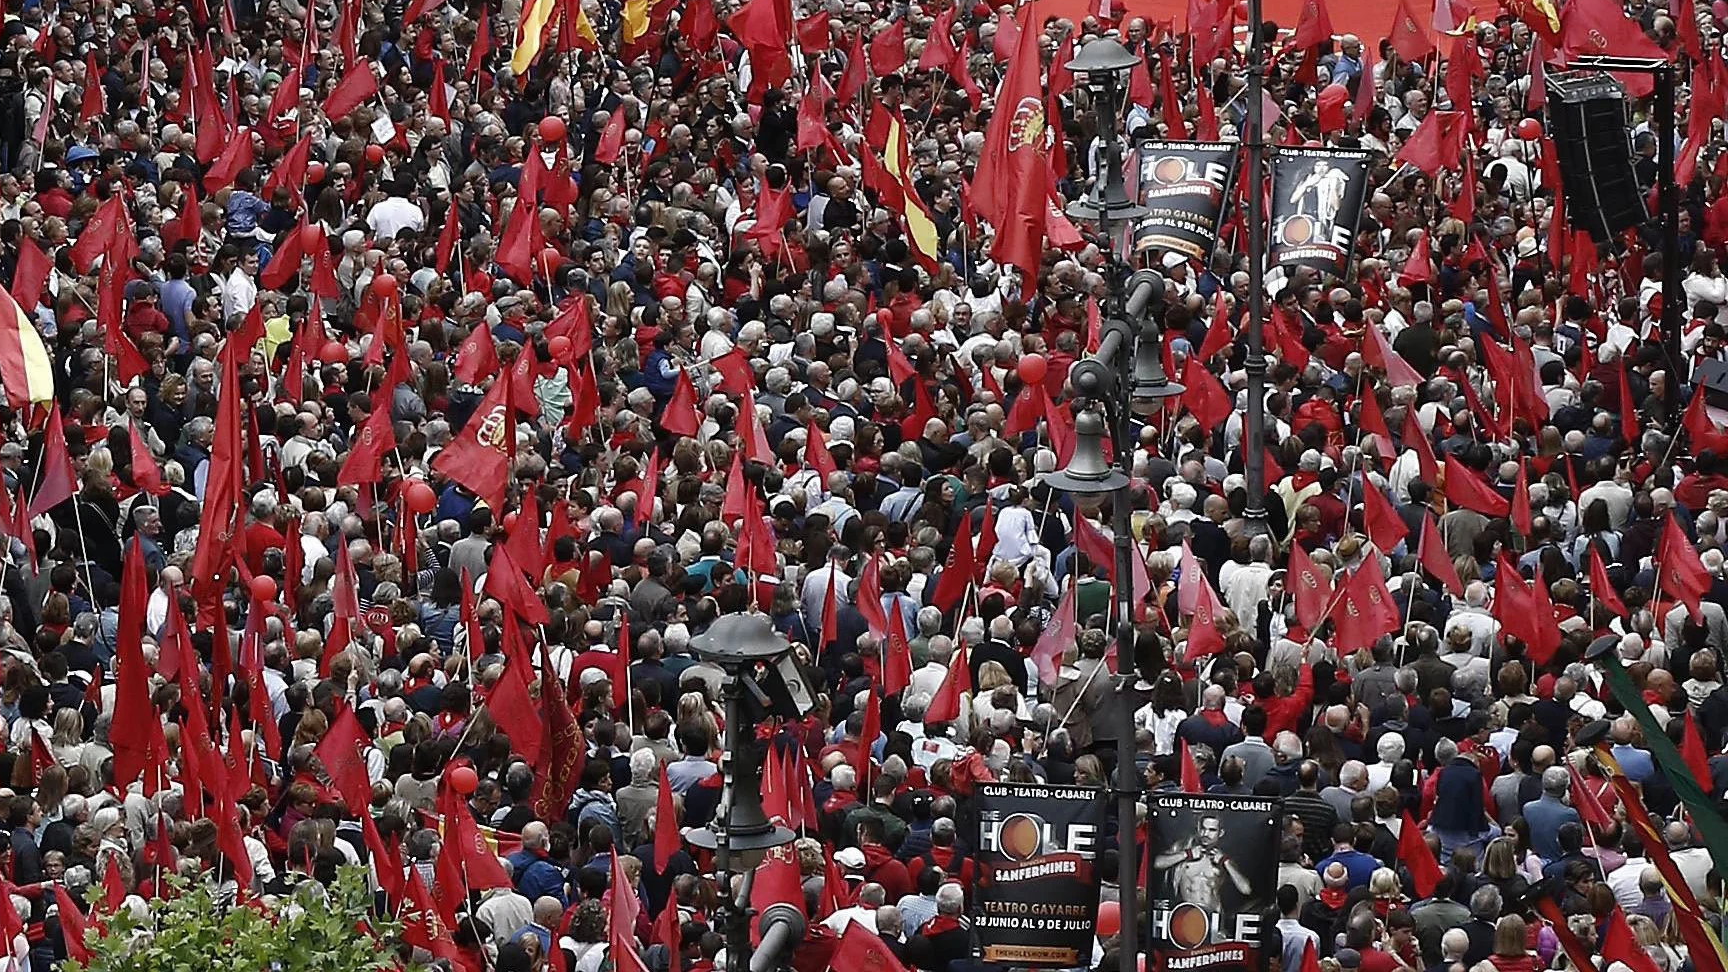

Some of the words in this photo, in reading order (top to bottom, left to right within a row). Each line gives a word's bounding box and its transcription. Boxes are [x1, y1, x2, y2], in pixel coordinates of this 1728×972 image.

[1141, 155, 1229, 191] HOLE
[1272, 214, 1352, 255] HOLE
[983, 785, 1008, 796] CLUB
[1013, 787, 1049, 798] TEATRO
[1054, 789, 1096, 800] CABARET
[1158, 797, 1183, 807] CLUB
[1189, 799, 1225, 809] TEATRO
[1230, 800, 1272, 811] CABARET
[980, 810, 1000, 821] THE
[980, 813, 1097, 861] HOLE
[995, 861, 1076, 881] SANFERMINES
[984, 901, 1028, 914] TEATRO
[1031, 903, 1087, 916] GAYARRE
[975, 916, 986, 926] 28
[987, 916, 1019, 928] JUNIO
[1021, 918, 1035, 929] AL
[1037, 918, 1045, 929] 9
[1047, 919, 1061, 930] DE
[1063, 920, 1091, 930] JULIO
[1152, 902, 1261, 950] HOLE
[1168, 950, 1244, 969] SANFERMINES
